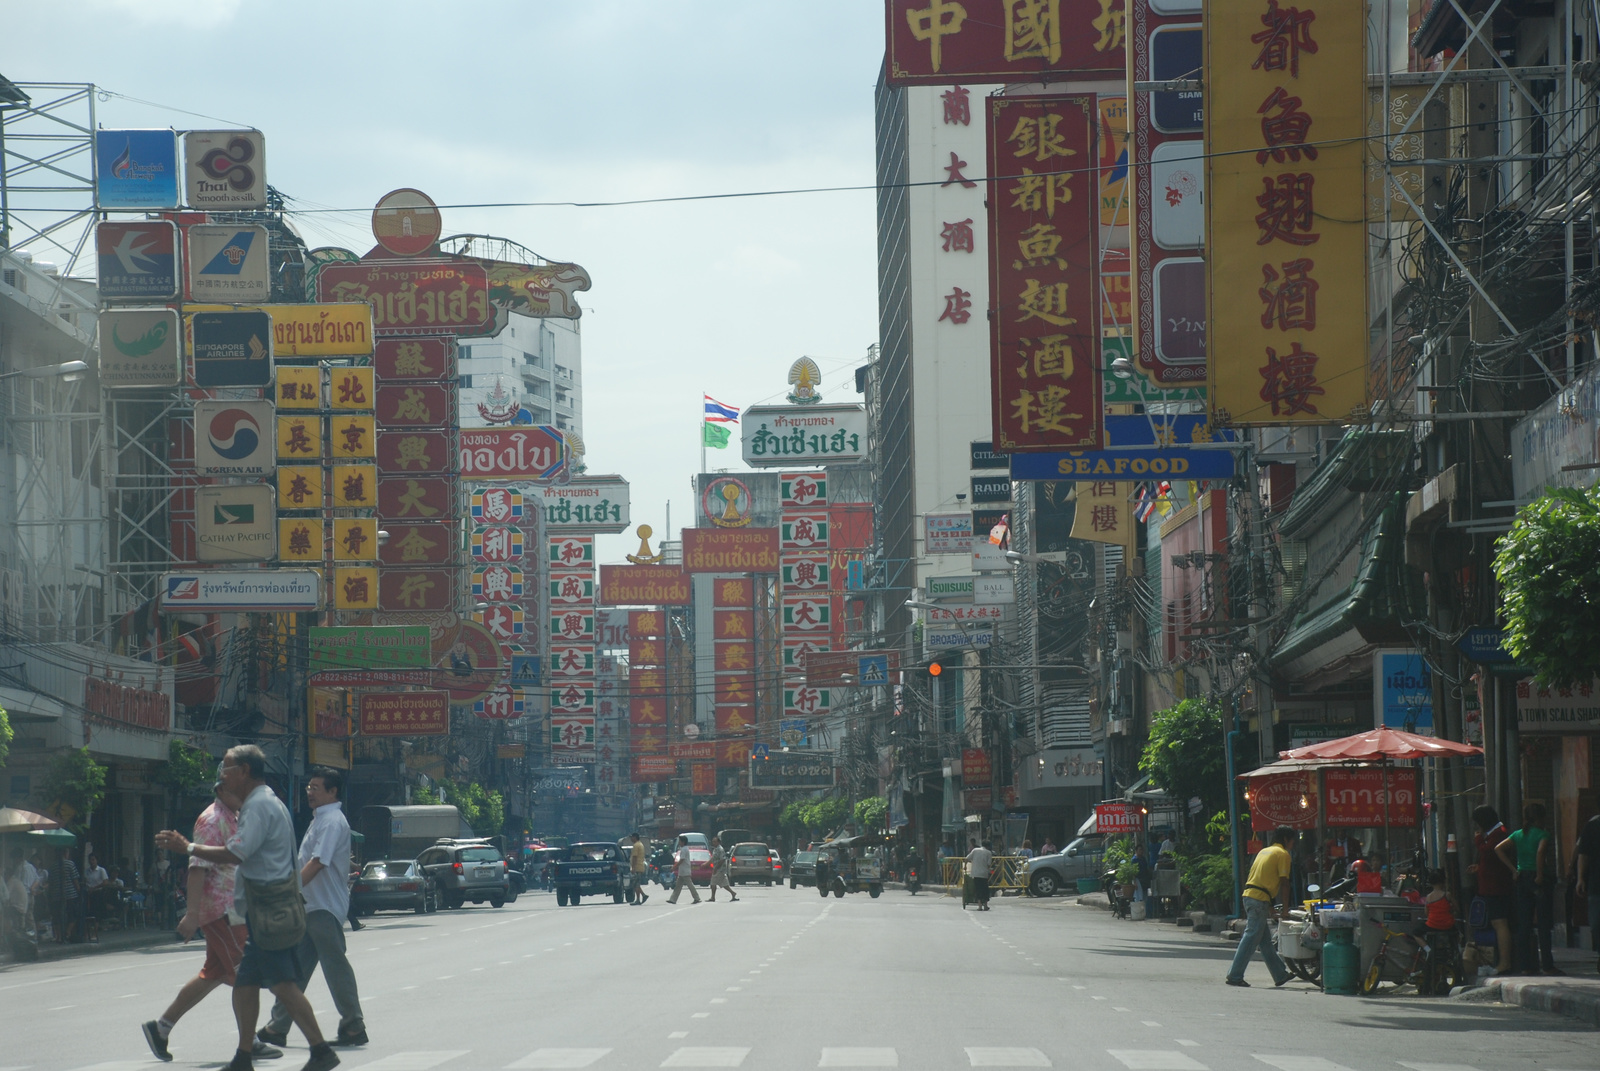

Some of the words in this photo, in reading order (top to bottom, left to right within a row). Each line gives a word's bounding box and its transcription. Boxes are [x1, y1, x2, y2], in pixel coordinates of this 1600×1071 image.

[132, 161, 165, 172] Bangkok
[197, 180, 228, 192] Thai
[197, 193, 230, 202] Smooth
[241, 193, 256, 202] silk
[1058, 457, 1189, 474] SEAFOOD
[974, 483, 1009, 492] RADO
[979, 517, 999, 525] MID
[200, 534, 236, 543] CATHAY
[238, 532, 271, 541] PACIFIC
[485, 490, 513, 716] 馬利興大行
[930, 633, 975, 645] BROADWAY
[636, 612, 662, 780] 聯成興大金
[1524, 708, 1548, 722] TOWN
[1549, 708, 1576, 722] SCALA
[1329, 782, 1412, 804] เกาลัด
[1373, 814, 1382, 823] A
